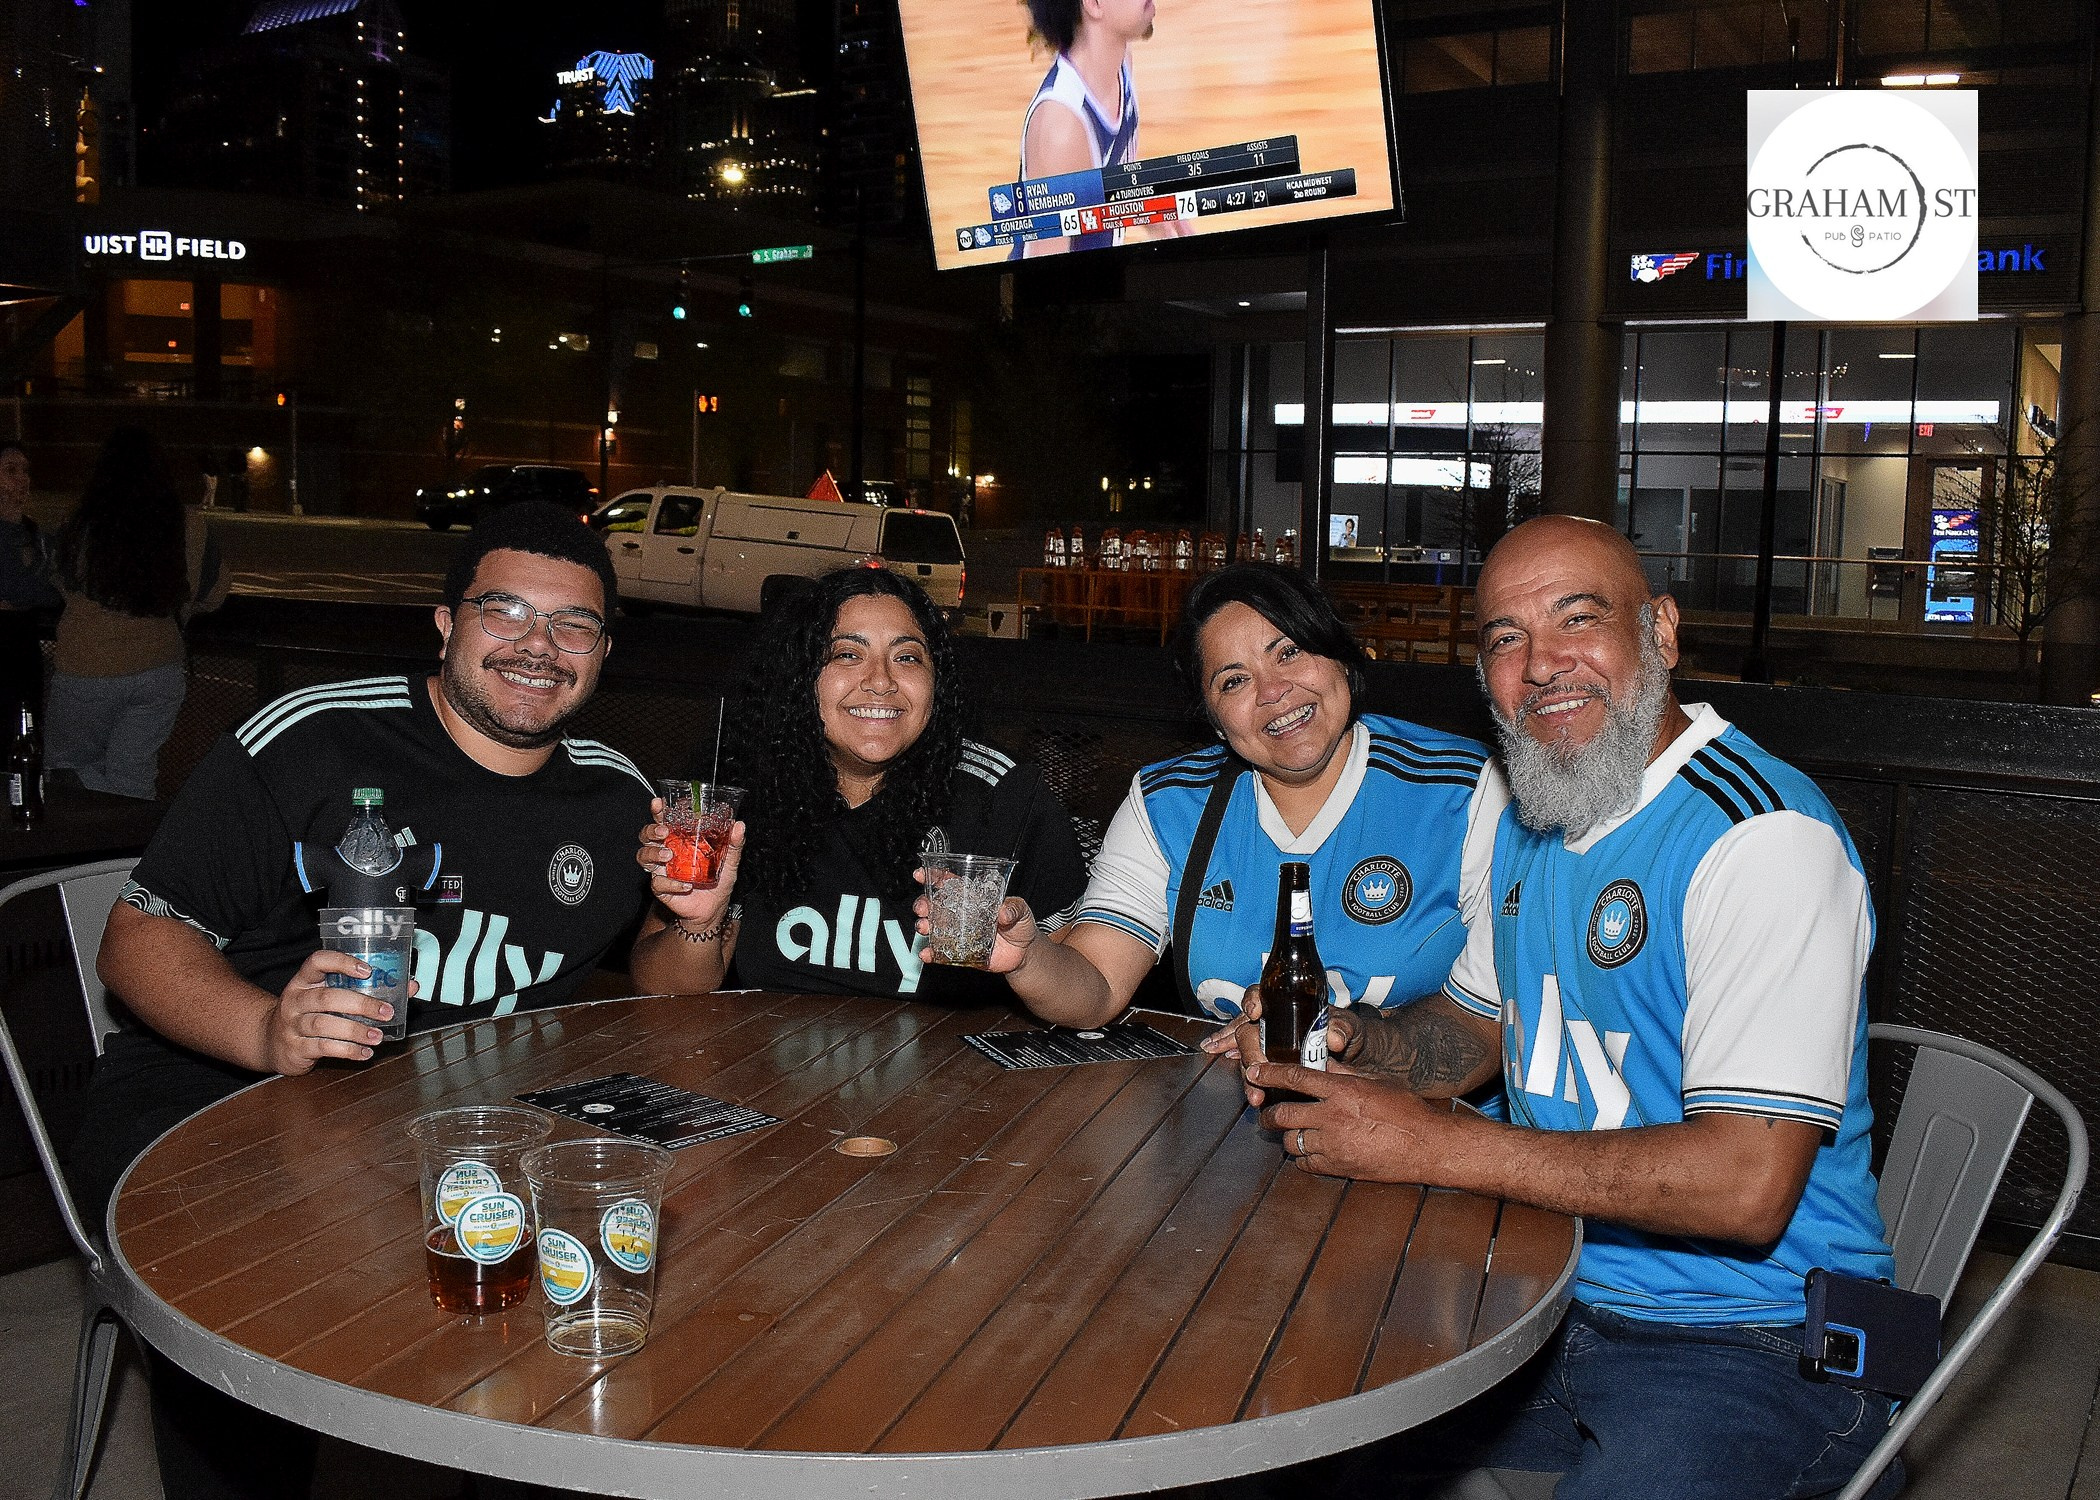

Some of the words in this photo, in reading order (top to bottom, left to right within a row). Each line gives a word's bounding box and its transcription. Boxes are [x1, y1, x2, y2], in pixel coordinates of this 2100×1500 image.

[557, 67, 595, 85] TRUIST
[1247, 141, 1268, 151] ASSISTS
[1177, 153, 1191, 163] FIELD
[1191, 151, 1209, 161] GOALS
[1253, 153, 1265, 165] 11
[1123, 163, 1142, 172] POINTS
[1188, 163, 1202, 176] 3/5
[1131, 174, 1137, 185] 8
[1286, 179, 1303, 189] NCAA
[1304, 176, 1332, 188] MIDWEST
[1016, 187, 1022, 199] G
[1026, 183, 1048, 197] RYAN
[1120, 186, 1154, 199] TURNOVERS
[1254, 190, 1266, 203] 29
[1304, 187, 1327, 197] ROUND
[1028, 192, 1075, 211] NEMBHARD
[1201, 198, 1217, 210] 2ND
[1226, 191, 1246, 206] 4:27
[1109, 201, 1145, 215] HOUSTON
[1179, 197, 1195, 214] 76
[1063, 214, 1078, 231] 65
[1163, 212, 1177, 221] POSS
[1000, 219, 1034, 233] GONZAGA
[959, 235, 973, 245] TNT
[176, 237, 246, 260] FIELD
[1919, 424, 1934, 436] EXIT
[556, 847, 590, 867] CHARLOTTE
[1353, 862, 1401, 881] CHARLOTTE
[575, 889, 587, 901] CLUB
[1601, 888, 1639, 913] CHARLOTTE
[1351, 902, 1382, 918] FOOTBALL
[1384, 901, 1400, 915] CLUB
[337, 909, 403, 941] ally
[776, 894, 930, 993] ally
[1591, 936, 1613, 960] FOOTBALL
[1614, 943, 1632, 958] CLUB
[413, 909, 564, 1017] ally
[667, 1136, 706, 1149] FOOD
[482, 1201, 505, 1211] SUN
[470, 1209, 515, 1222] CRUISER
[547, 1237, 566, 1250] SUN
[541, 1244, 578, 1262] CRUISER
